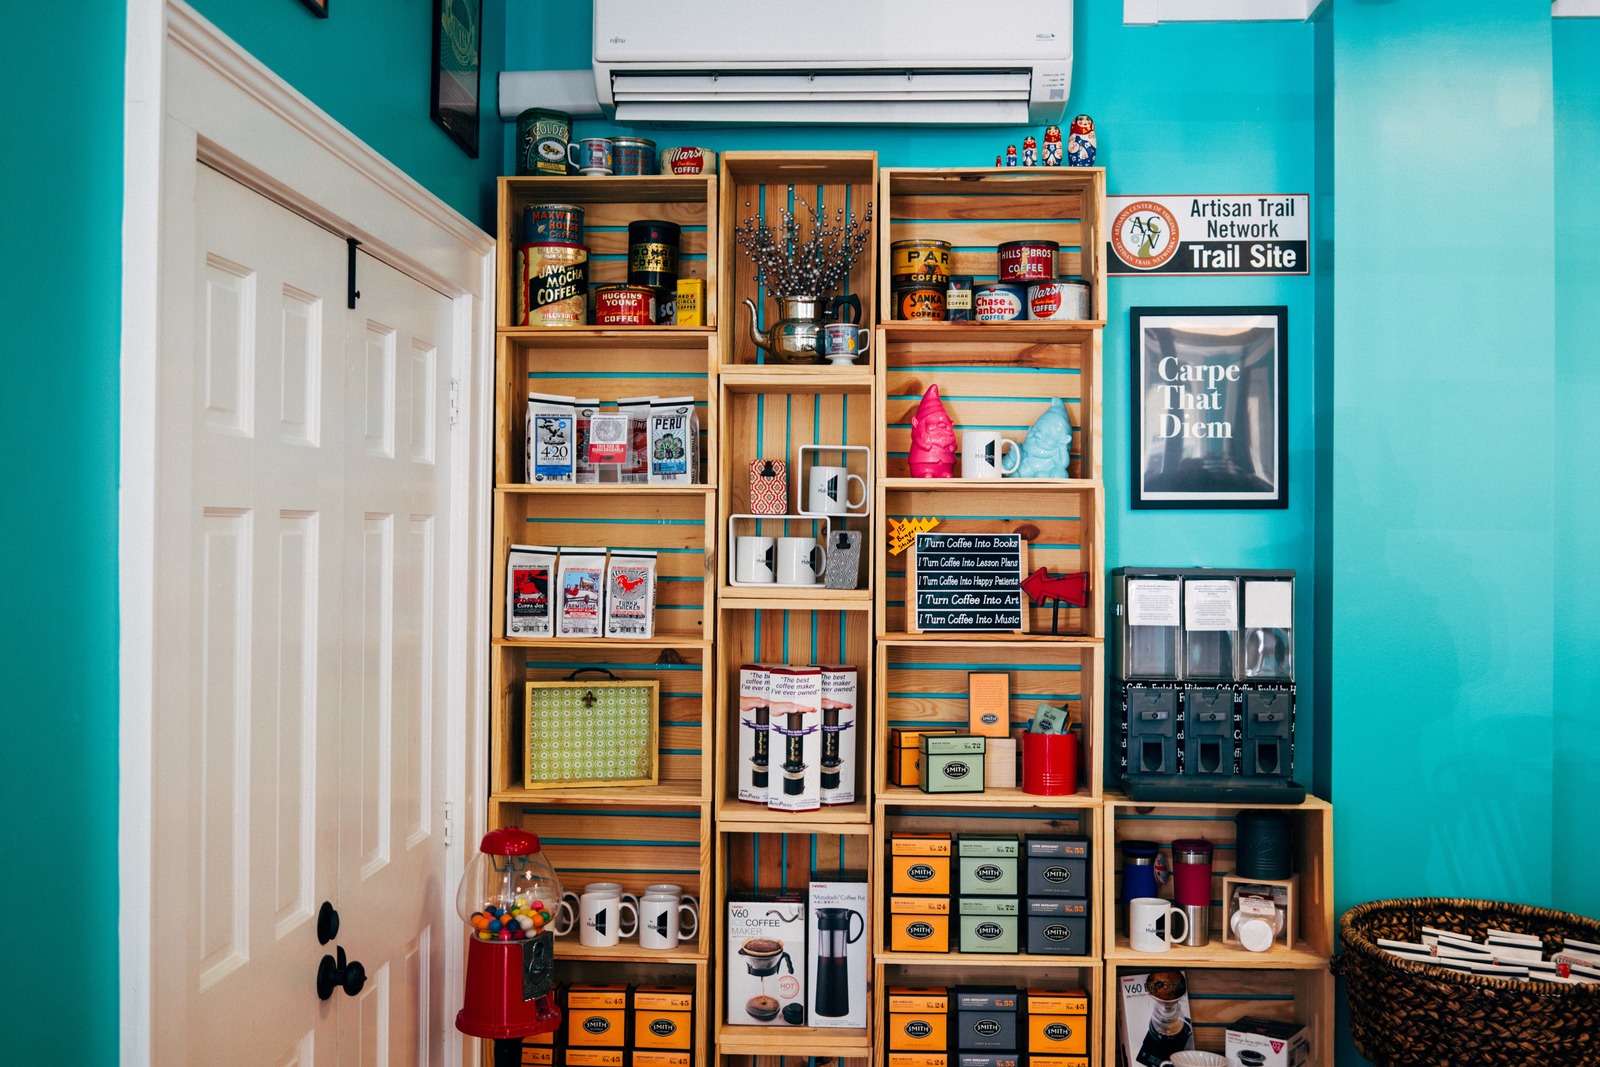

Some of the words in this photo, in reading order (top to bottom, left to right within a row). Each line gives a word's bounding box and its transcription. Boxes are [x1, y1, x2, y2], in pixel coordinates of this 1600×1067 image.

[533, 123, 570, 140] GOLDEN
[670, 147, 705, 162] Marsh
[1190, 199, 1252, 218] Artisan
[1257, 198, 1295, 217] Trail
[532, 211, 580, 224] MAXWELL
[1114, 210, 1130, 236] ARTISANS
[1129, 203, 1153, 212] CENTER
[1161, 210, 1177, 236] VIRGINIA
[549, 221, 579, 232] HOUSE
[1207, 219, 1279, 239] Network
[907, 251, 949, 265] PAR
[1001, 249, 1021, 260] HILLS
[1030, 248, 1052, 258] BROS
[1115, 241, 1134, 261] ARTISAN
[1152, 241, 1176, 264] NETWORK
[1188, 244, 1240, 268] Trail
[1250, 243, 1297, 268] Site
[539, 263, 566, 279] JAVA
[1008, 263, 1043, 273] COFFEE
[546, 269, 584, 288] MOCHA
[911, 274, 947, 283] COFFEE
[602, 292, 643, 300] HUGGINS
[1031, 284, 1064, 300] Marsh
[909, 292, 942, 307] SANKA
[975, 297, 1006, 306] Chase
[974, 305, 1015, 315] Sanborn
[1033, 304, 1058, 312] COFFEE
[604, 315, 639, 323] COFFEE
[1158, 356, 1241, 390] Carpe
[1157, 385, 1223, 410] That
[655, 417, 682, 430] PERU
[1157, 413, 1234, 439] Diem
[918, 538, 923, 548] I
[924, 537, 945, 548] Turn
[947, 537, 972, 548] Coffee
[974, 537, 991, 548] Into
[992, 537, 1018, 548] Books
[918, 558, 922, 567] I
[922, 557, 939, 567] Turn
[940, 557, 961, 567] Coffee
[962, 557, 975, 567] Into
[976, 557, 999, 567] Lesson
[1000, 557, 1018, 567] Plans
[918, 577, 922, 586] I
[922, 576, 938, 586] Turn
[938, 576, 959, 586] Coffee
[959, 576, 972, 586] Into
[973, 576, 993, 588] Happy
[994, 576, 1019, 586] Patients
[918, 595, 923, 605] I
[925, 594, 949, 605] Turn
[951, 594, 980, 605] Coffee
[982, 594, 1002, 605] Into
[1004, 594, 1019, 605] Art
[918, 614, 923, 624] I
[924, 613, 946, 624] Turn
[947, 613, 973, 624] Coffee
[975, 613, 993, 624] Into
[994, 613, 1019, 624] Music
[731, 909, 749, 918] V60
[731, 927, 763, 936] MAKER
[1124, 983, 1142, 994] V60
[1272, 1042, 1281, 1051] 02
